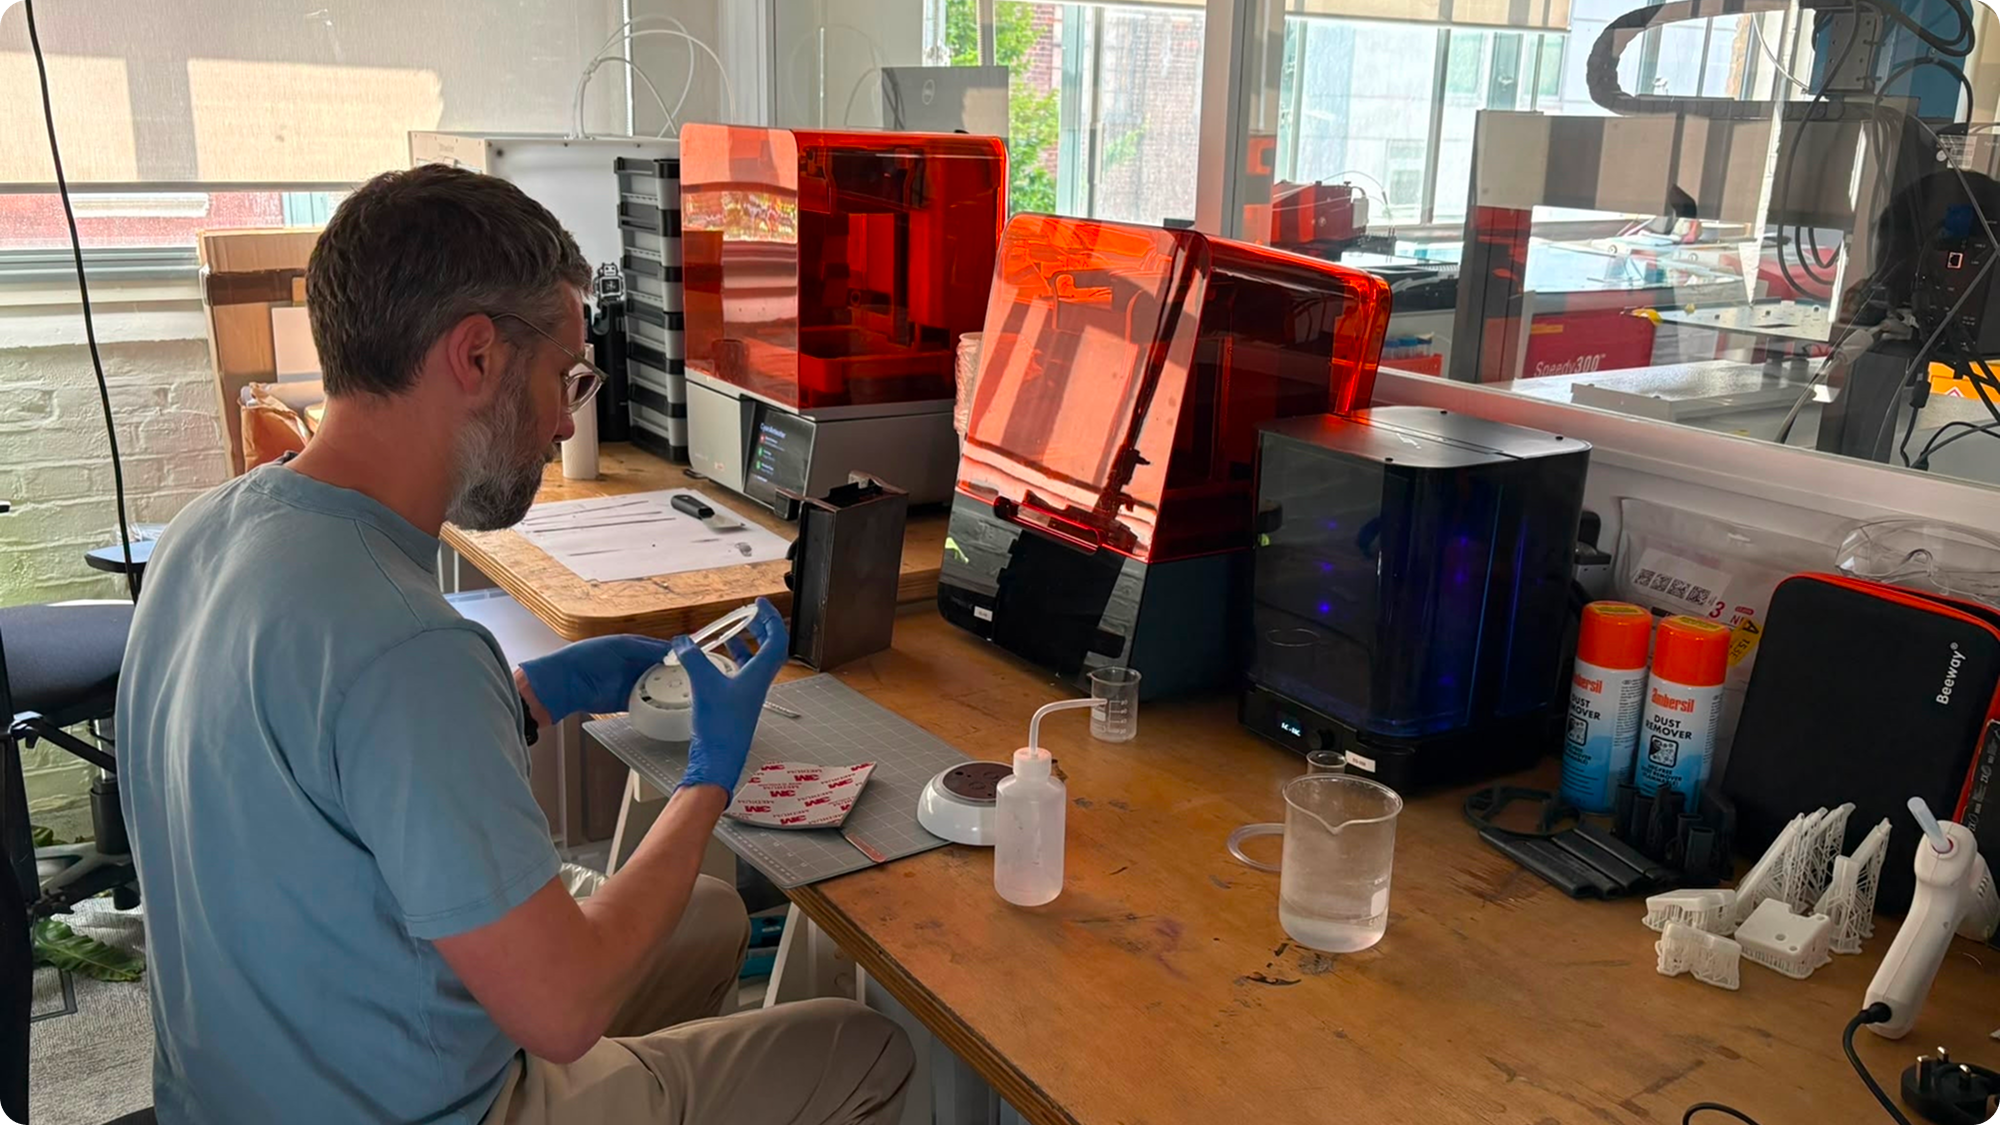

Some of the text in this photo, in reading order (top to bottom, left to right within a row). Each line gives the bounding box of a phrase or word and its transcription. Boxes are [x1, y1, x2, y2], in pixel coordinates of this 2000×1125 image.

[1654, 714, 1681, 729] DUST
[1645, 719, 1693, 740] REMOVER
[793, 774, 820, 782] 3M
[828, 778, 853, 789] 3M
[770, 789, 796, 798] 3M
[804, 796, 831, 808] 3M
[744, 805, 771, 813] 3M
[780, 815, 807, 825] 3M
